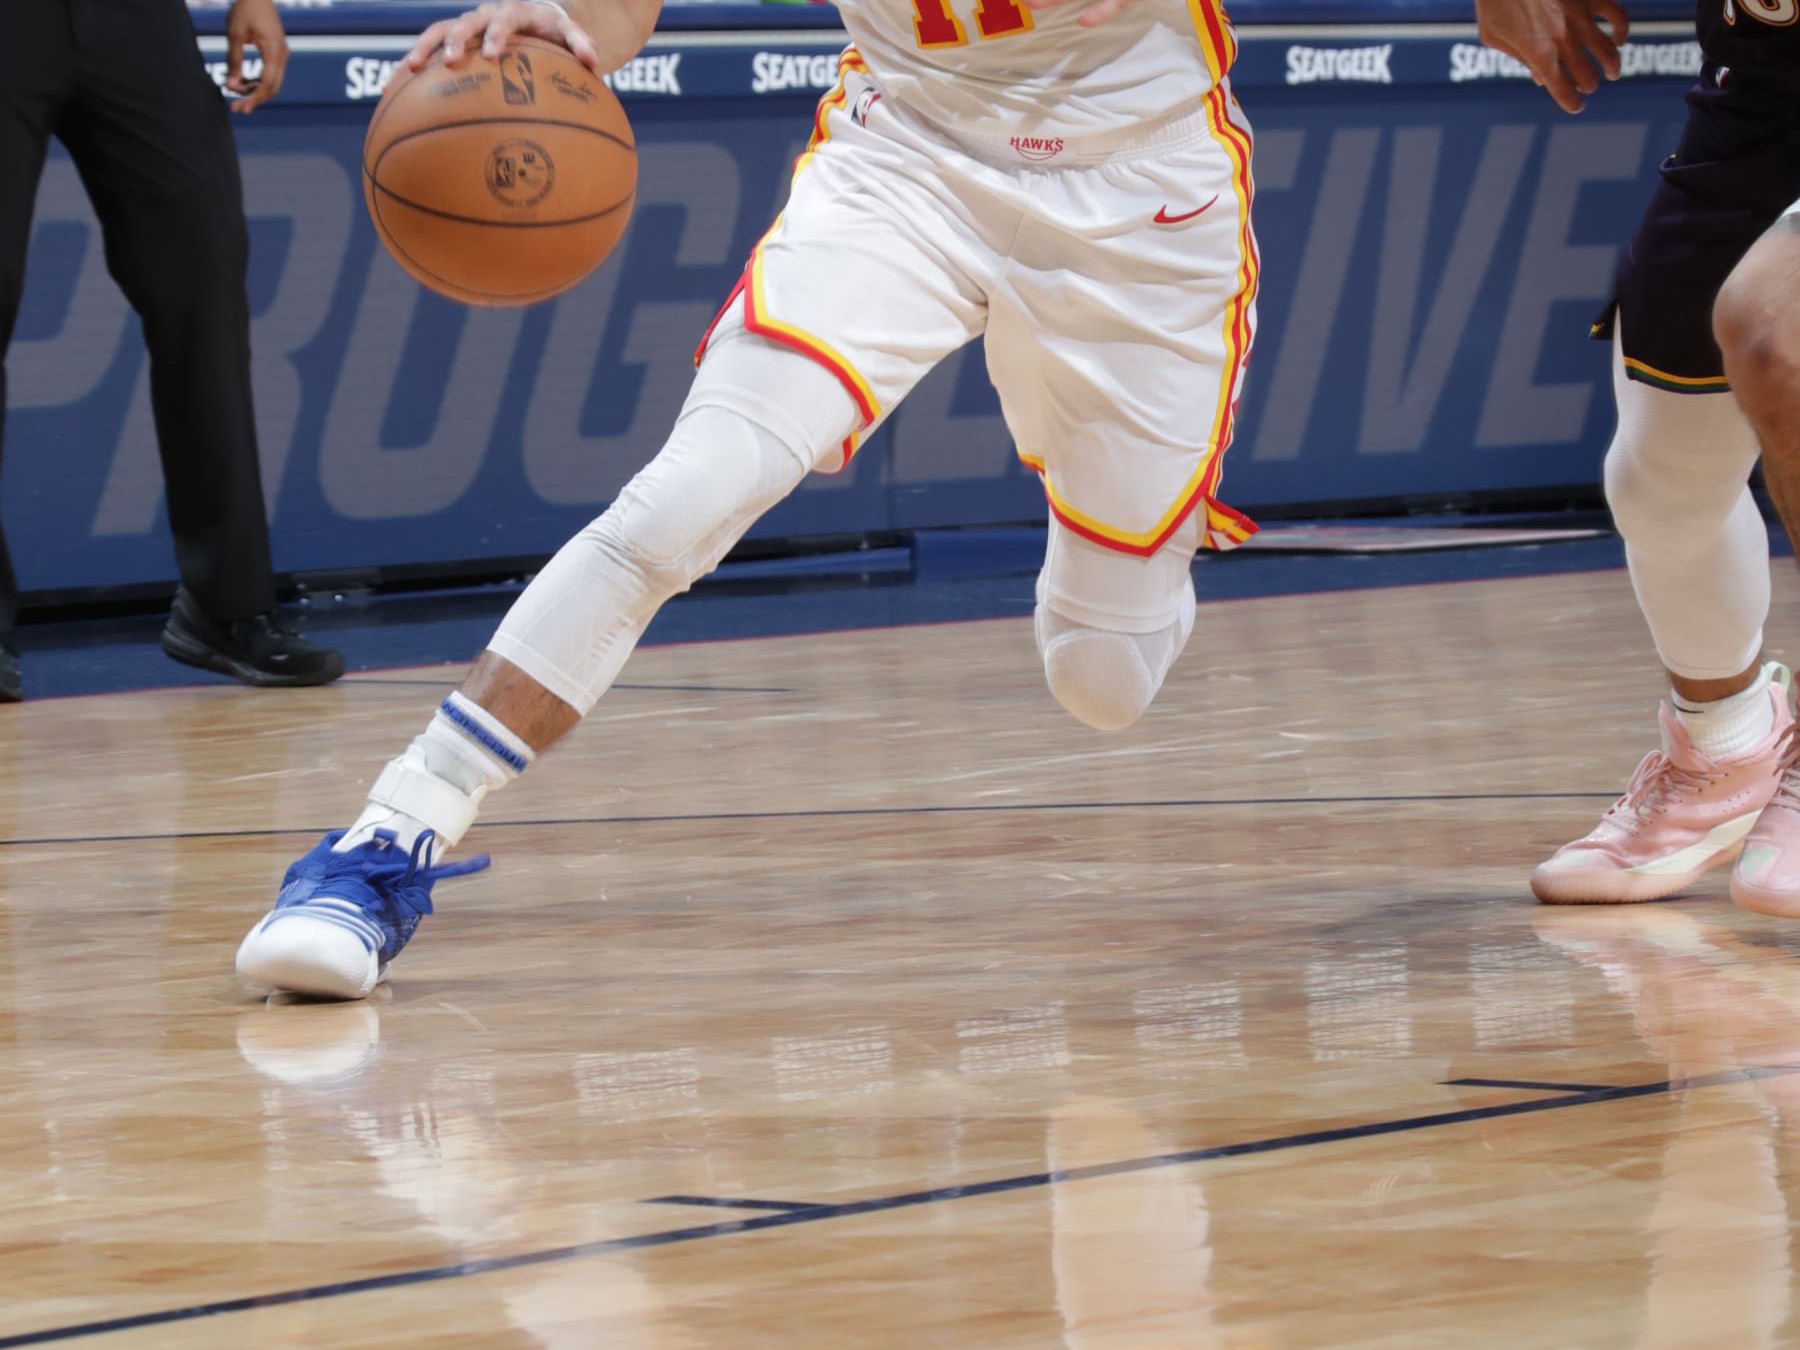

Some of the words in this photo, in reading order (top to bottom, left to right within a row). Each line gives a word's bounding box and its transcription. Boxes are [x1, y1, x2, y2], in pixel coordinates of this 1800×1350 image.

[603, 52, 681, 95] GEEK
[752, 52, 839, 93] SEATGE
[1286, 44, 1393, 85] SEATGEEK
[1449, 43, 1532, 82] SEATG
[1617, 42, 1704, 77] EATGEEK
[1009, 136, 1064, 153] HAWKS
